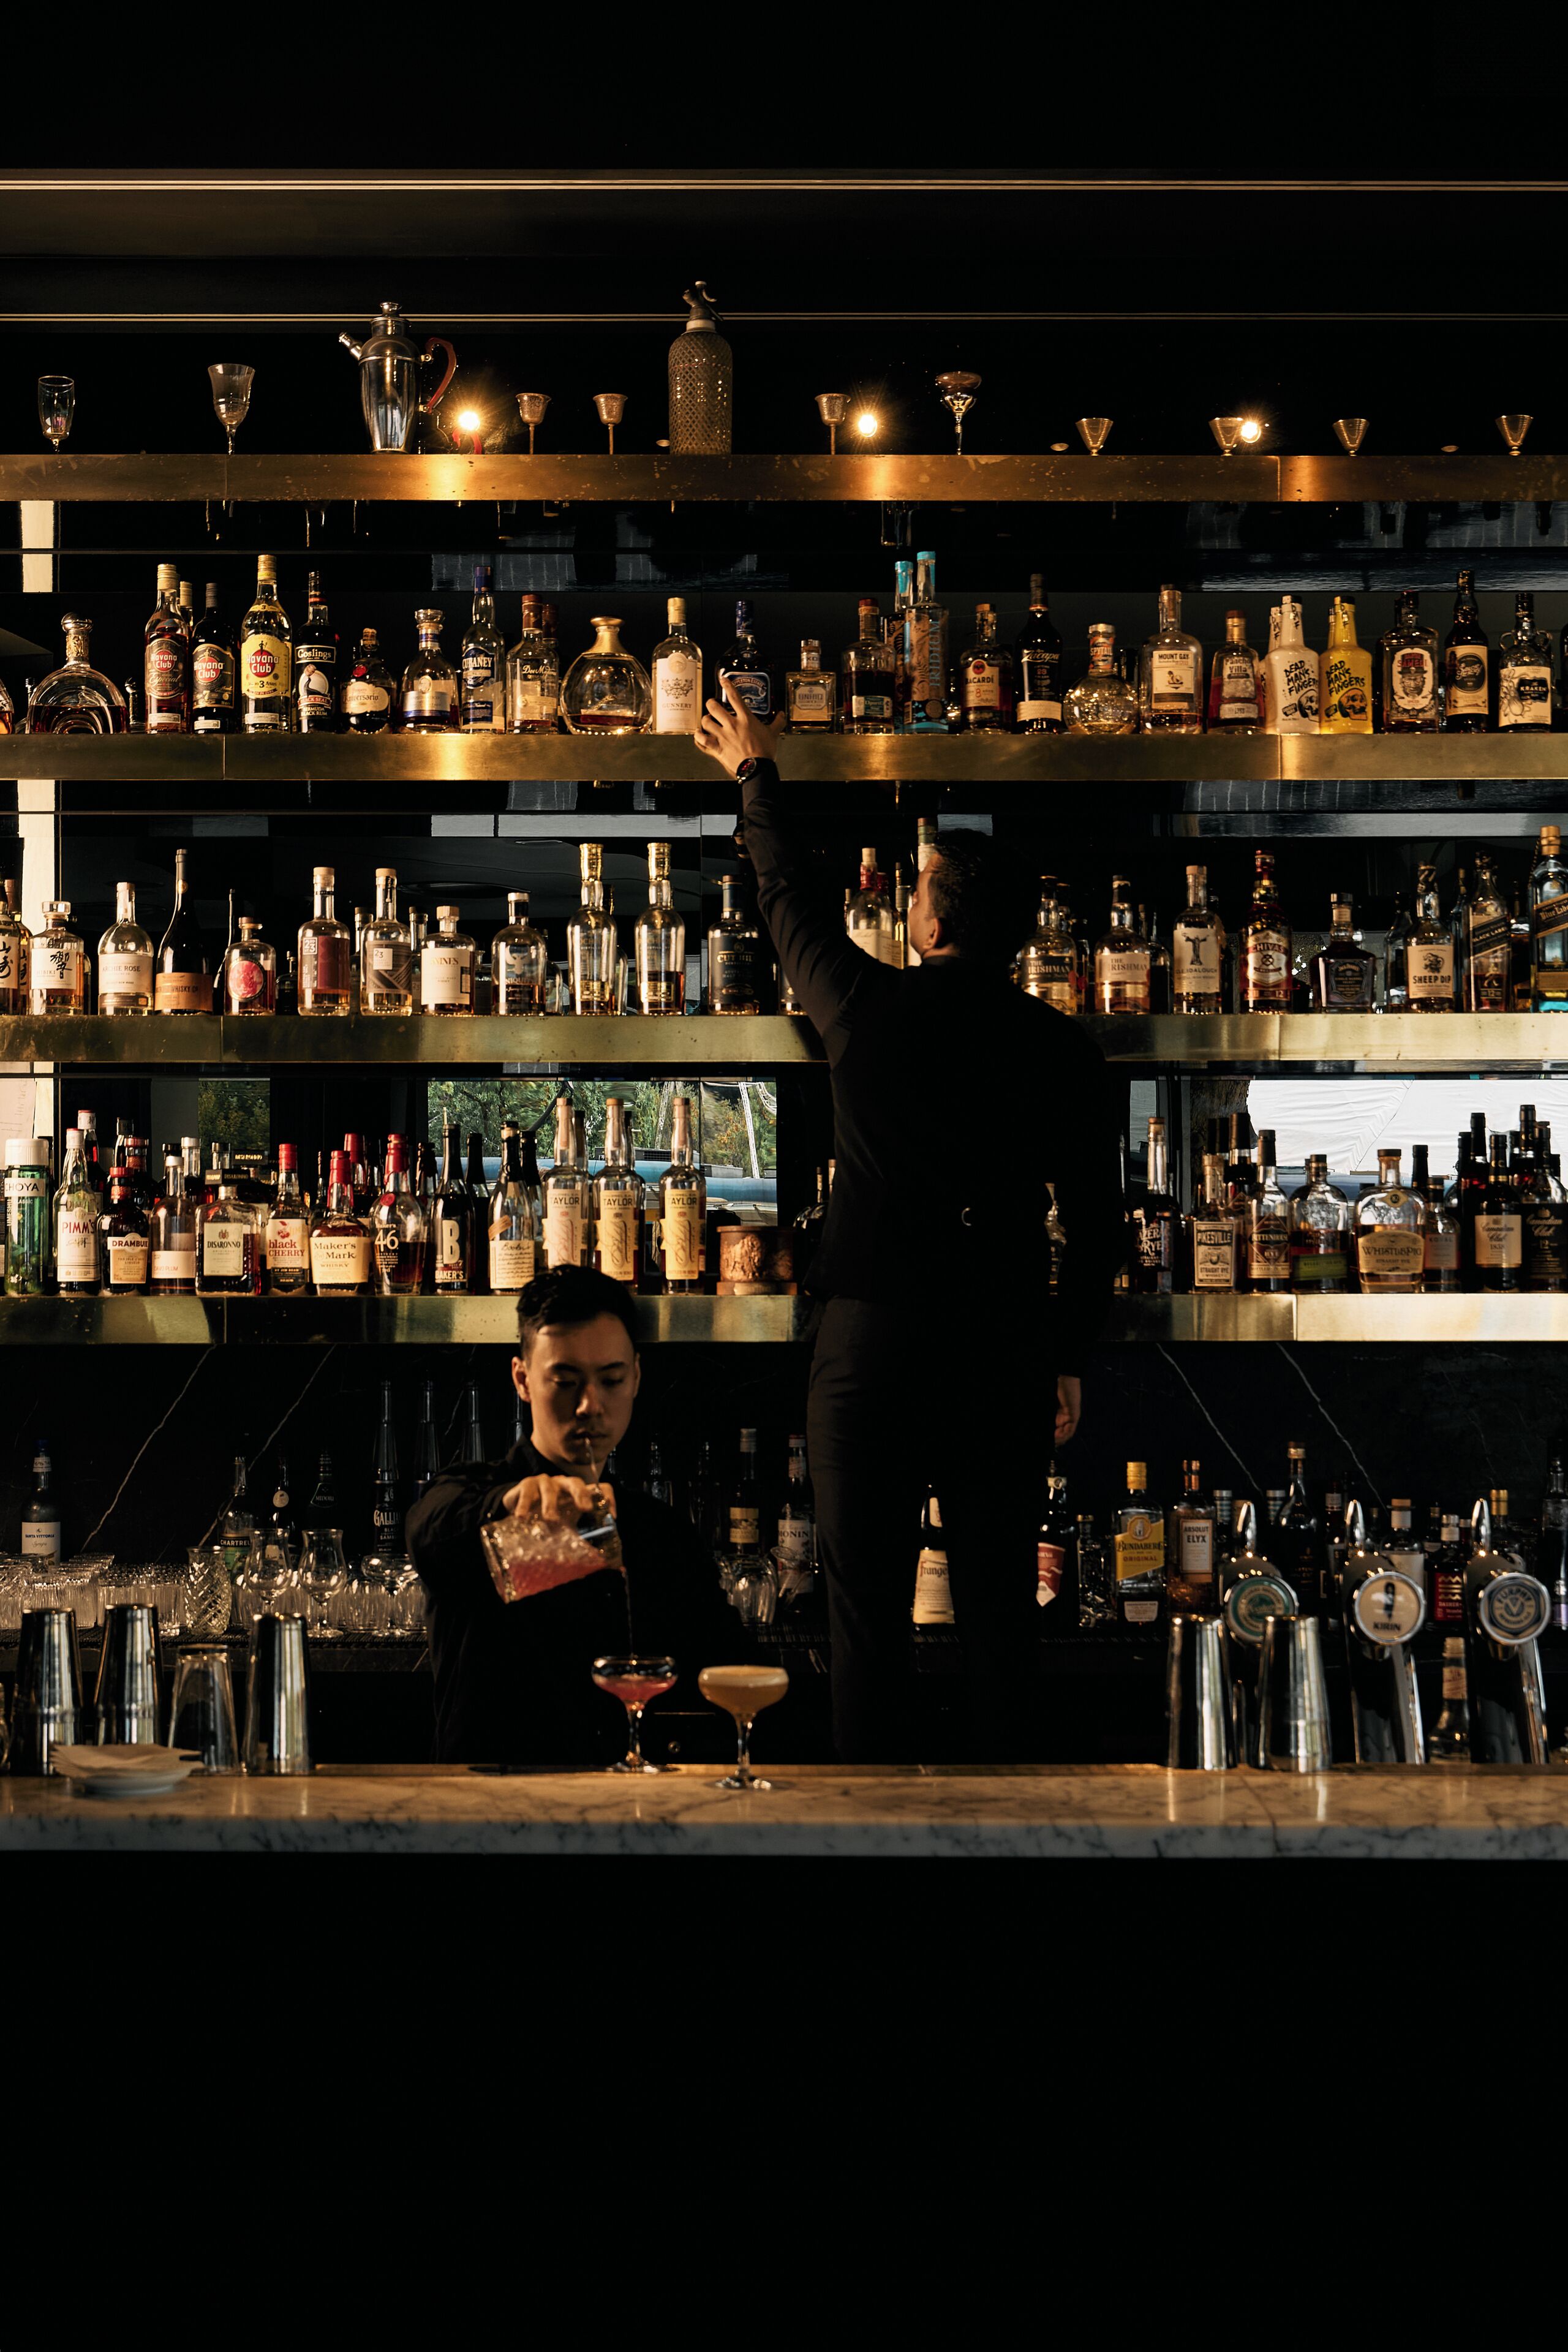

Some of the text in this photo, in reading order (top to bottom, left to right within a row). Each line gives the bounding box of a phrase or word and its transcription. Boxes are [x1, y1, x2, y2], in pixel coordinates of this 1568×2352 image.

[298, 649, 331, 660] Goslings
[930, 620, 940, 686] IRIDIUM
[1090, 647, 1113, 655] SPYTAIL
[245, 654, 280, 665] Havana
[194, 662, 223, 670] Havana
[251, 664, 271, 673] Club
[1284, 660, 1305, 677] DEAD
[1325, 660, 1344, 677] DEAD
[965, 675, 994, 684] BACARDÍ
[1287, 667, 1310, 685] MAN'S
[1327, 667, 1351, 687] MAN'S
[1329, 676, 1365, 696] FINGERS
[975, 688, 981, 698] 8
[1556, 906, 1568, 916] Labe
[1252, 943, 1284, 952] CHIVAS
[1028, 965, 1070, 974] IRISHMAN
[1412, 975, 1451, 984] SHEEP DIP
[6, 1183, 39, 1191] CHOYA
[551, 1197, 579, 1205] TAYLOR
[603, 1197, 633, 1206] TAYLOR
[668, 1197, 696, 1205] TAYLOR
[62, 1219, 95, 1234] PIMM'S
[1480, 1222, 1514, 1232] Canadian
[1532, 1225, 1555, 1236] Club
[375, 1229, 399, 1253] 46
[442, 1219, 460, 1264] B
[1197, 1231, 1231, 1244] PIKESVILLE
[1488, 1232, 1507, 1242] Club
[268, 1240, 296, 1249] black
[1141, 1240, 1162, 1256] RYE
[1540, 1240, 1549, 1249] 12
[435, 1270, 464, 1279] BAKER'S
[374, 1510, 399, 1526] GALLIA
[1117, 1542, 1163, 1552] BUNDABERG
[1373, 1622, 1401, 1630] KIRIN
